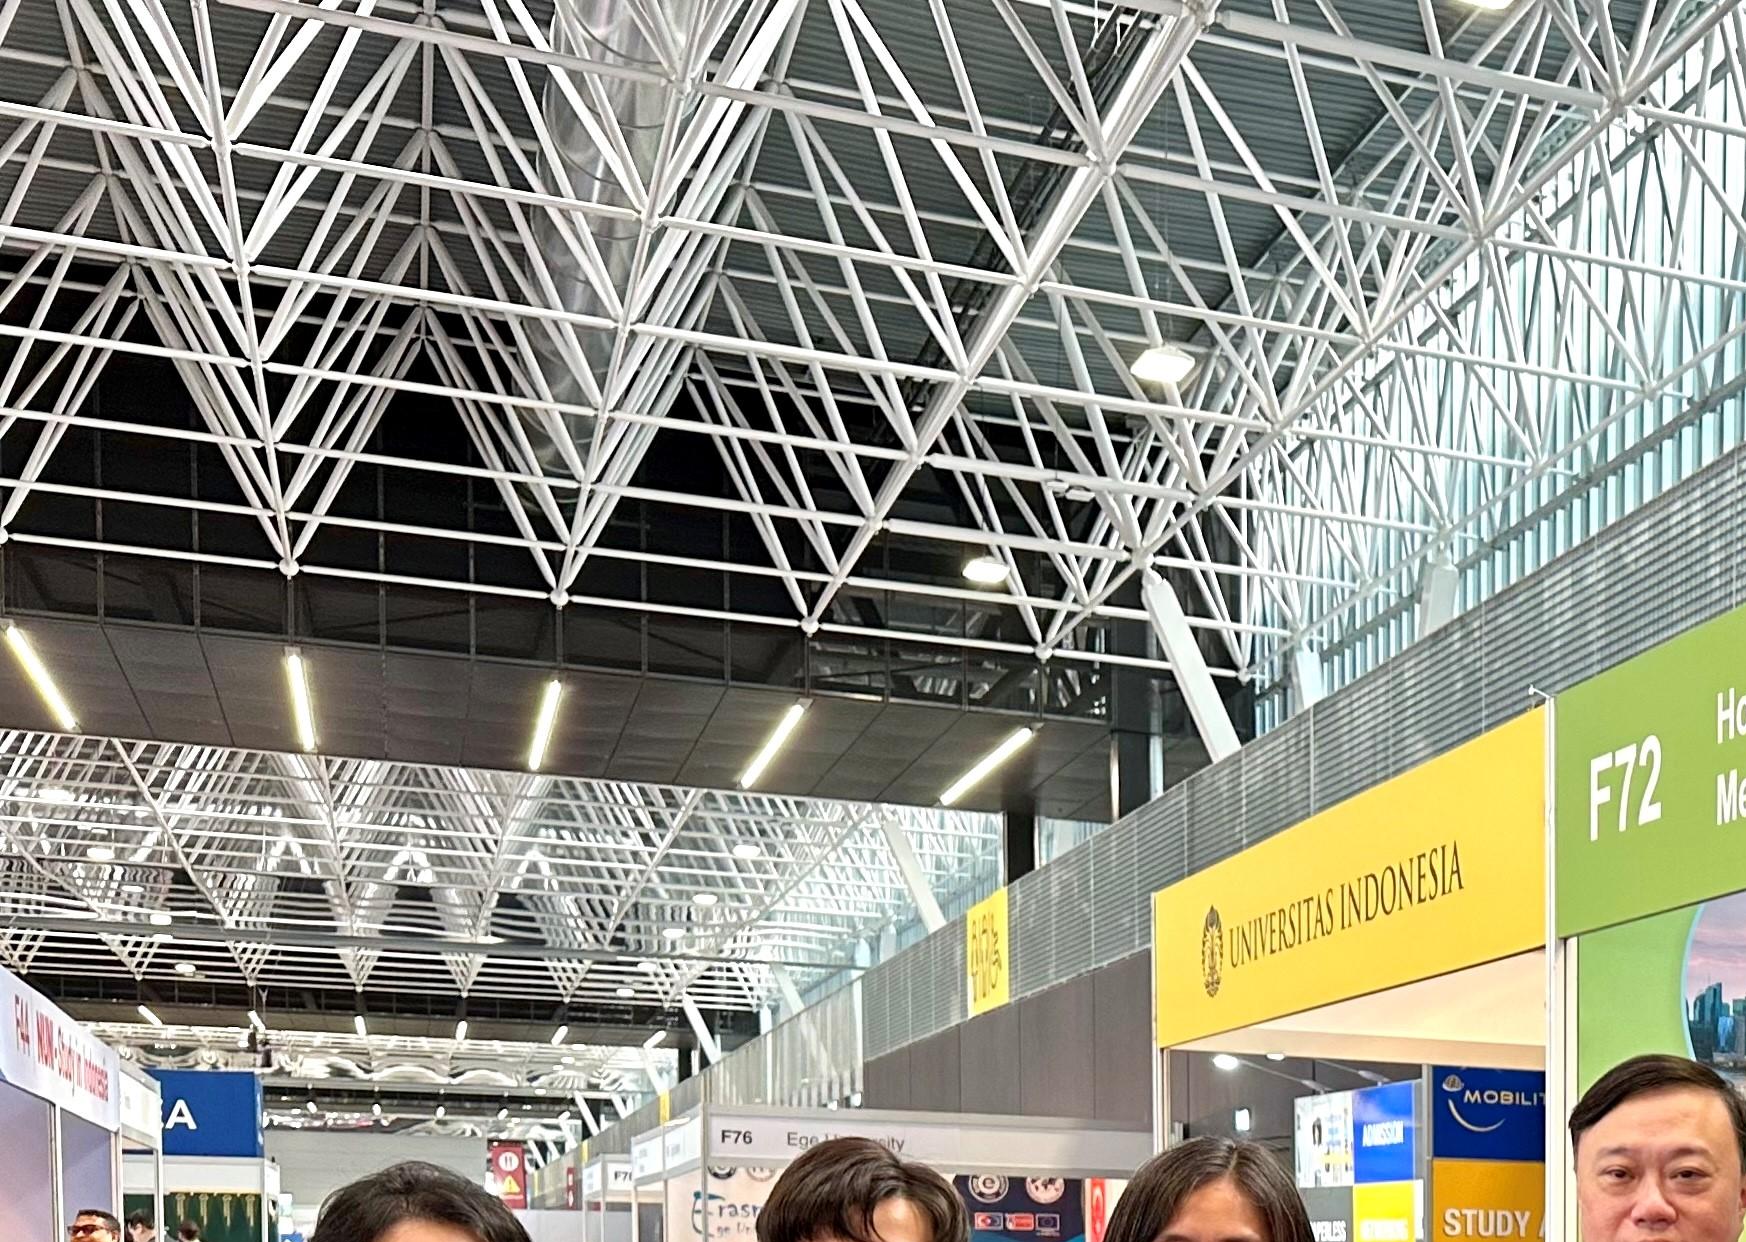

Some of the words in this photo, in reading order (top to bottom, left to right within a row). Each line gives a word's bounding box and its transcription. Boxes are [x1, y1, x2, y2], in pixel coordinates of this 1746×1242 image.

[1589, 734, 1662, 842] F72
[1229, 887, 1334, 969] UNIVERSITAS
[1340, 840, 1464, 930] INDONESIA
[14, 993, 31, 1057] F44
[720, 1129, 753, 1145] F76
[1444, 1207, 1531, 1238] STUDY
